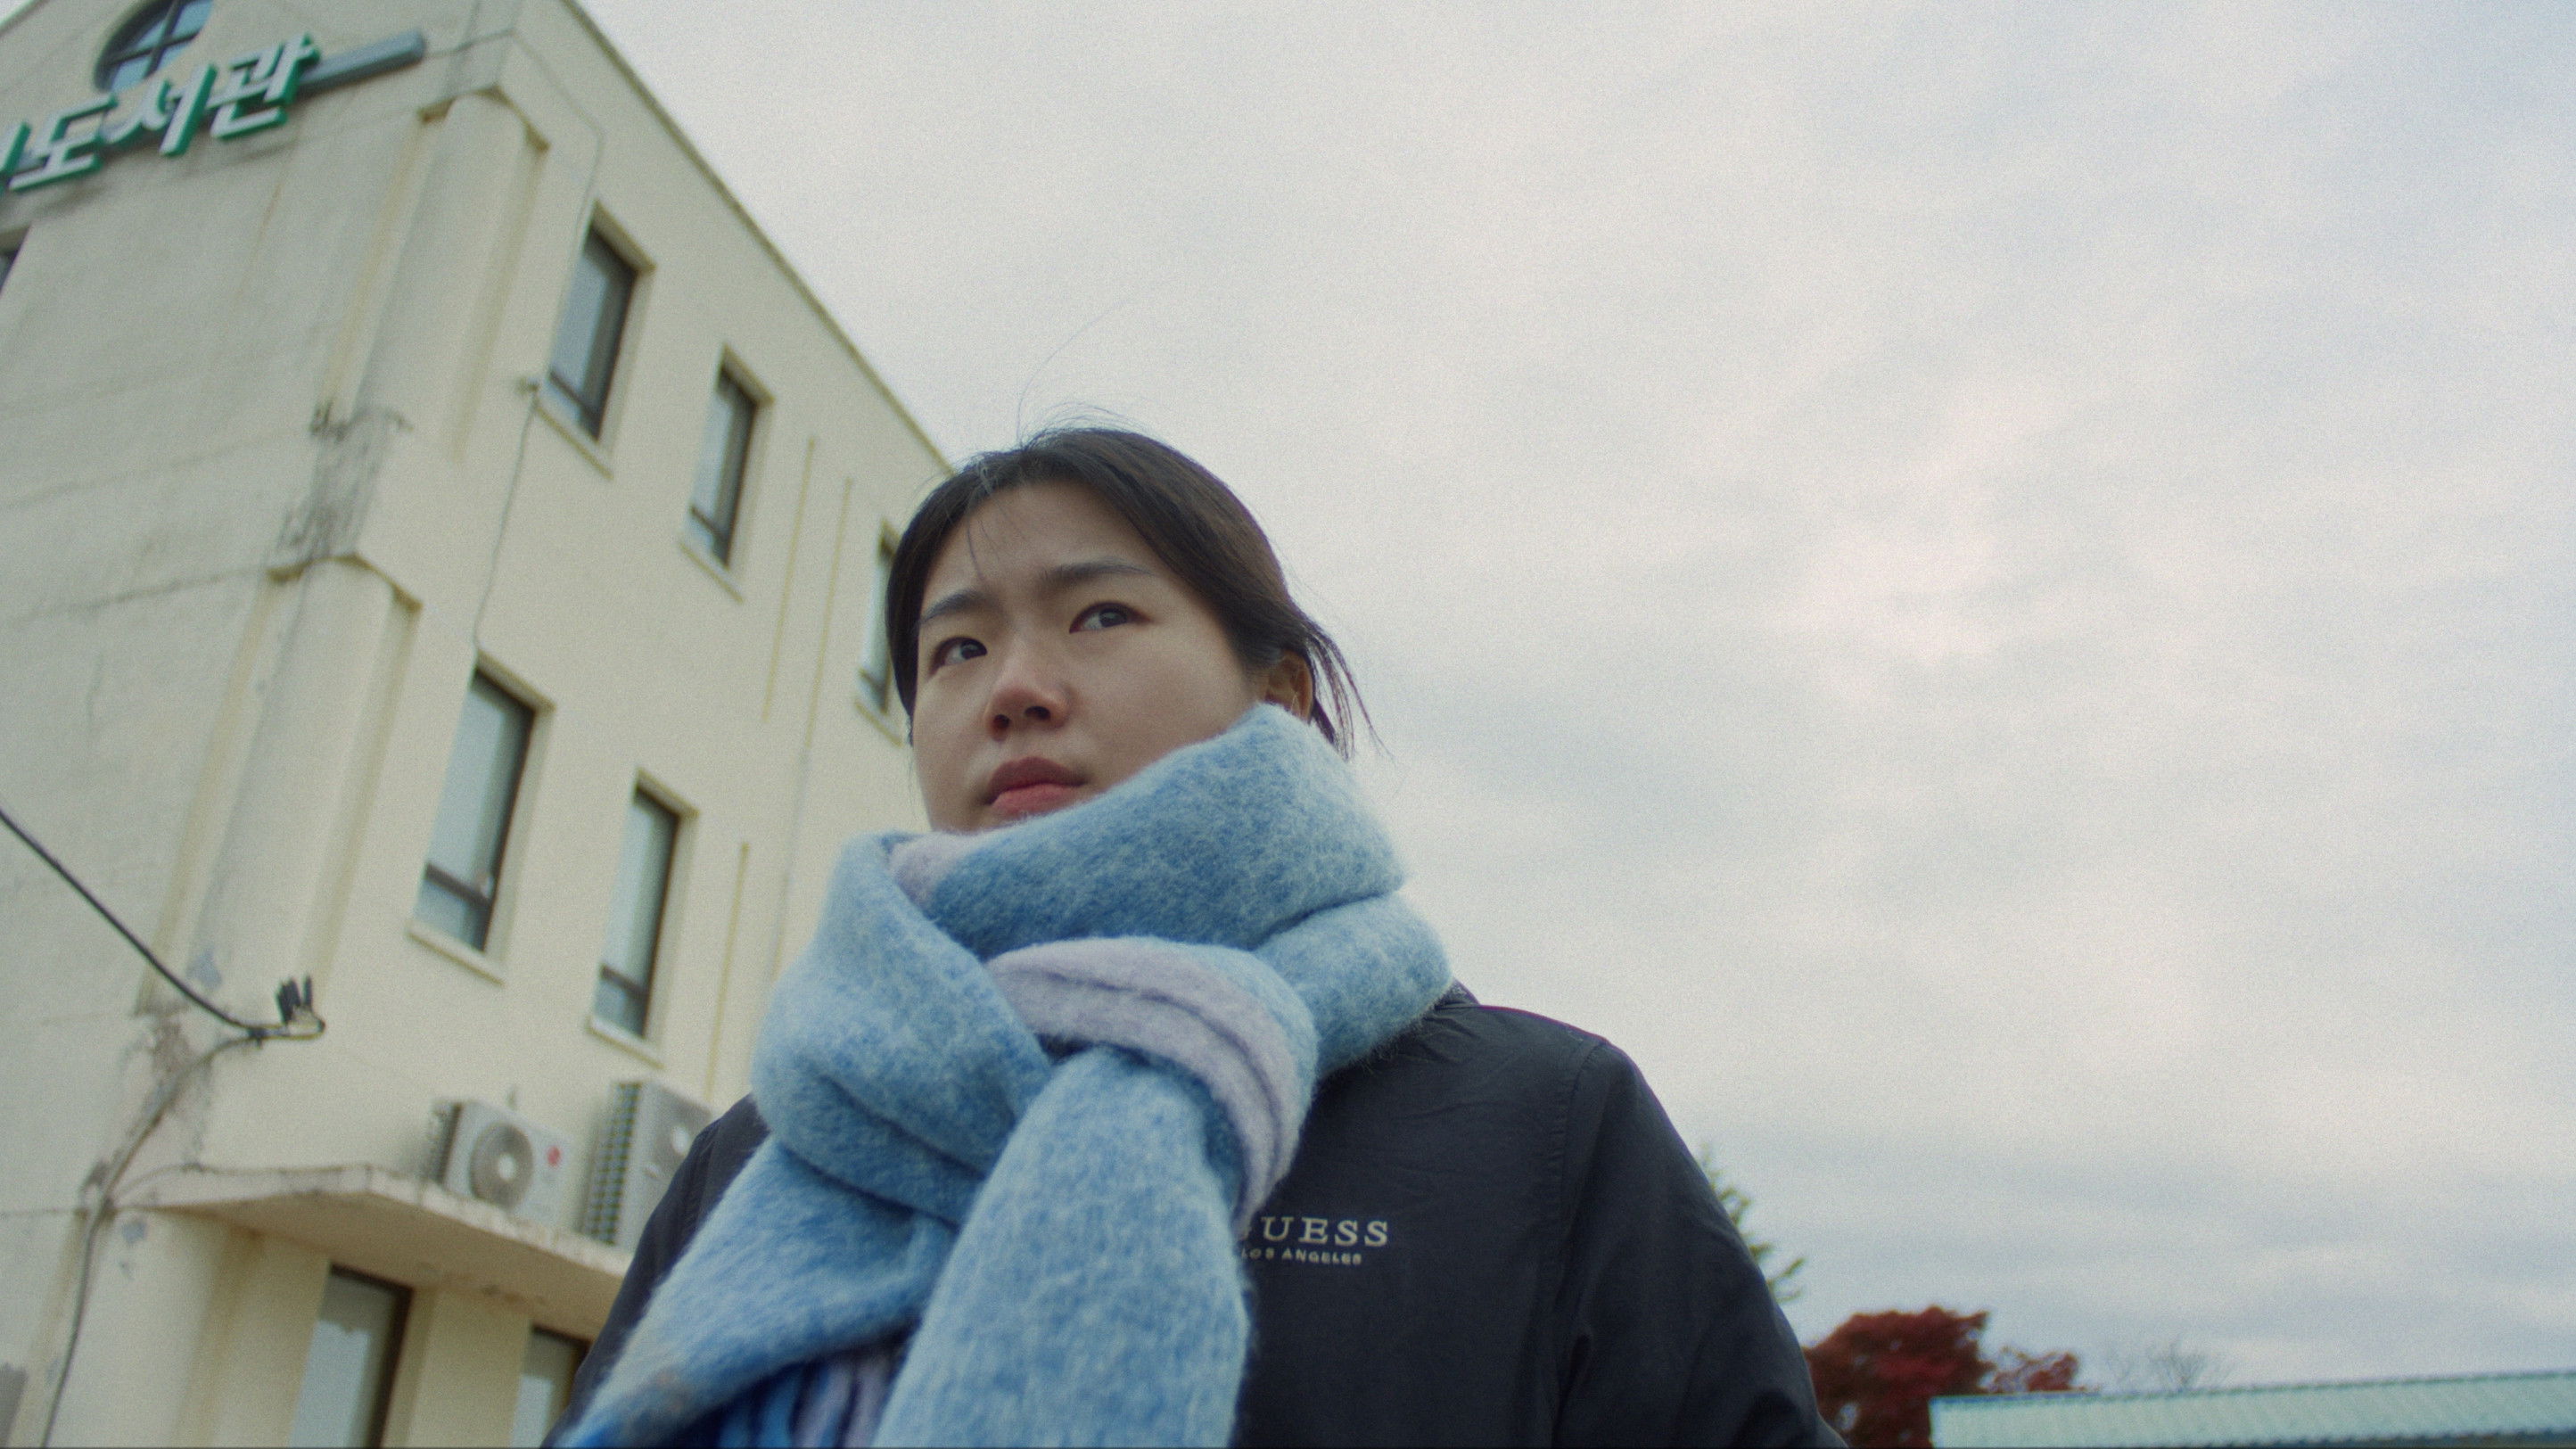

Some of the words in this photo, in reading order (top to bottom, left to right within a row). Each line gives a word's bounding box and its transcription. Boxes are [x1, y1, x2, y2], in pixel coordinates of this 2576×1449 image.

[0, 32, 321, 194] 도서관
[1240, 1216, 1388, 1247] UESS
[1281, 1248, 1362, 1264] ANGELES
